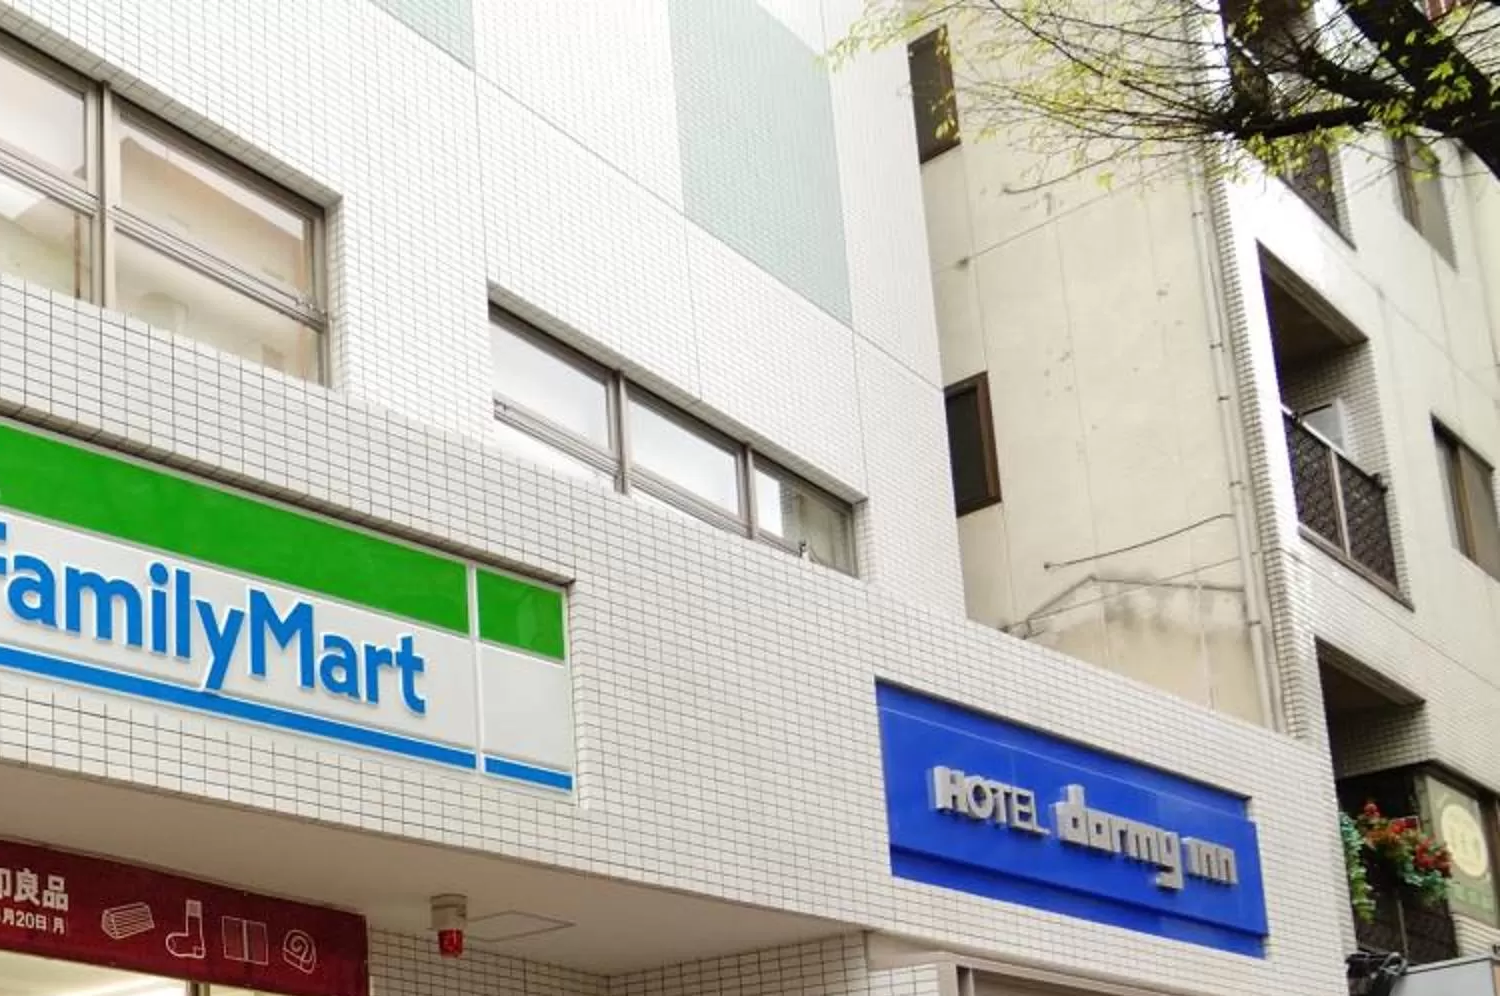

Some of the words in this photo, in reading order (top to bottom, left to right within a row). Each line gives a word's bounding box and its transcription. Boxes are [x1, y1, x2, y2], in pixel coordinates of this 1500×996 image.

[930, 765, 1049, 835] HOTEL
[1052, 783, 1183, 890] dormy
[1182, 836, 1238, 885] inn
